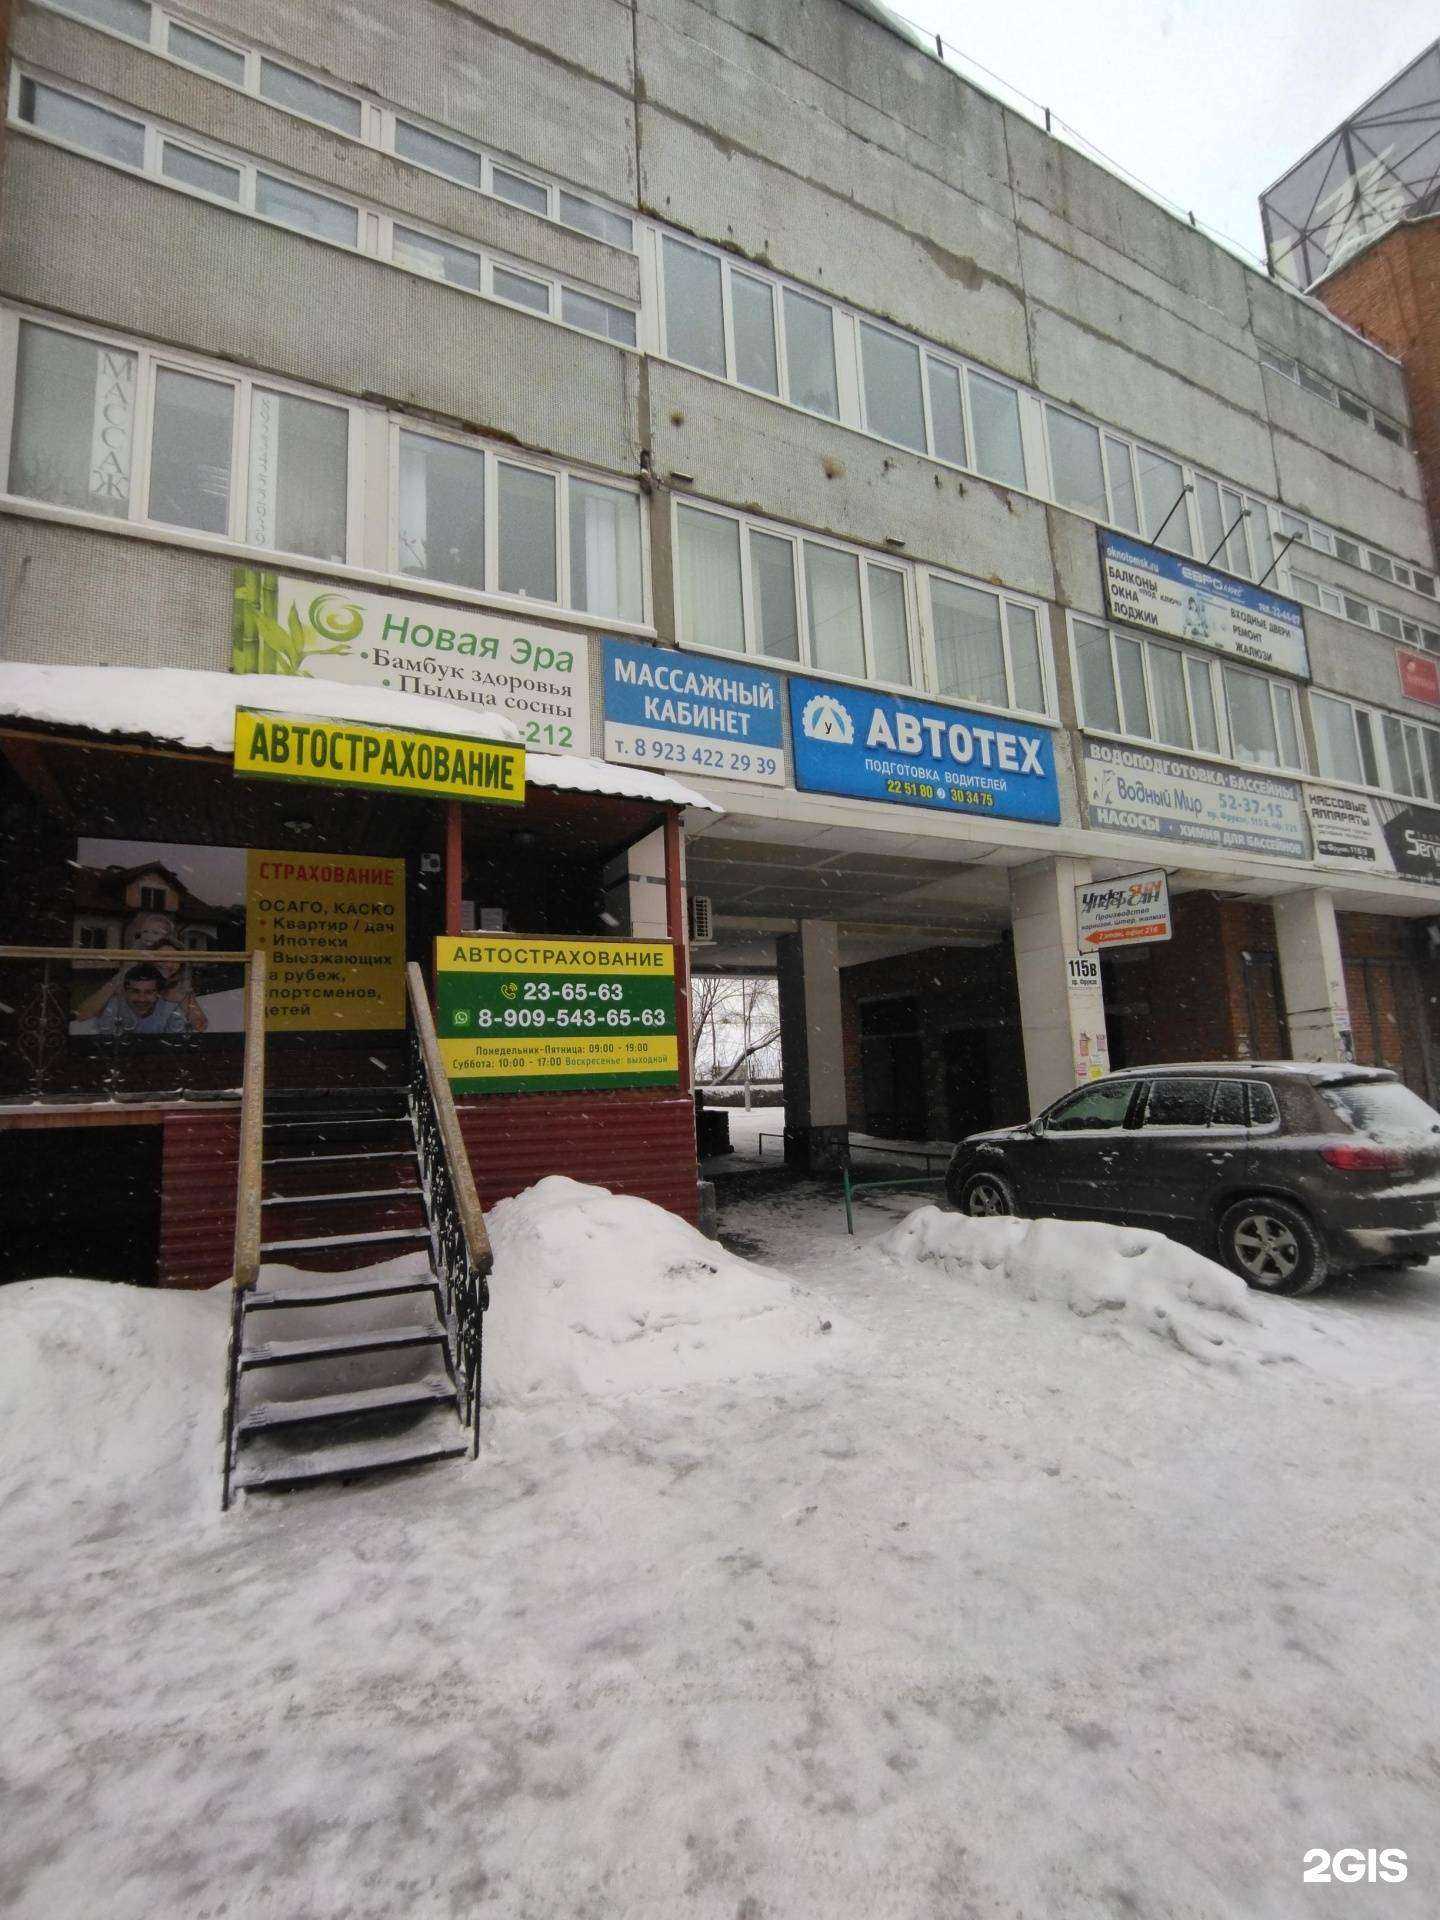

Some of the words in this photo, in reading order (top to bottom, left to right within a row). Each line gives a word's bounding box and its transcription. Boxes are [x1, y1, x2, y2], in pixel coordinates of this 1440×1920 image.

[92, 352, 136, 500] МАССАЖ
[1108, 567, 1158, 592] БАЛКОНЫ
[1111, 584, 1139, 602] ОКНА
[1114, 602, 1158, 625] ЛОДЖИИ
[1230, 608, 1268, 630] ВХОДНЫЕ
[1269, 623, 1292, 638] ДВЕРИ
[381, 613, 499, 659] Новая
[510, 638, 574, 673] Эра
[1232, 625, 1263, 643] РЕМОНТ
[1235, 642, 1273, 661] ЖАЛЮЗИ
[372, 647, 464, 680] Бамбук
[471, 670, 572, 697] здоровья
[614, 658, 774, 710] МАССАЖНЫЙ
[399, 674, 497, 707] Пыльца
[504, 695, 573, 718] сосны
[644, 696, 750, 736] КАБИНЕТ
[866, 708, 1045, 777] АВТОТЕХ
[250, 722, 514, 791] АВТОСТРАХОВАНИЕ
[615, 740, 628, 754] т.
[634, 738, 647, 757] 8
[652, 741, 686, 762] 923
[692, 747, 724, 768] 422
[730, 753, 750, 771] 29
[756, 757, 777, 775] 39
[865, 758, 940, 782] ПОДГОТОВКА
[944, 771, 1007, 791] ВОДИТЕЛЕЙ
[1117, 776, 1172, 808] Водный
[1173, 788, 1202, 818] Мир
[1309, 794, 1368, 813] КАССОВЫЕ
[1097, 807, 1160, 832] НАСОСЫ
[1311, 808, 1370, 826] АППАРАТЫ
[260, 863, 395, 886] СТРАХОВАНИЕ
[259, 899, 328, 915] ОСАГО,
[334, 902, 395, 916] КАСКО
[273, 918, 348, 933] Квартир
[365, 922, 394, 934] дач
[273, 935, 348, 949] Ипотеки
[273, 952, 392, 966] Выезжающих
[453, 946, 664, 967] АВТОСТРАХОВАНИЕ
[285, 969, 346, 982] рубеж,
[523, 982, 623, 1001] 23-65-63
[478, 1009, 666, 1027] 8-909-543-65-63
[588, 1044, 614, 1053] 09:00
[625, 1042, 648, 1052] 19:00
[453, 1060, 494, 1071] Суббота:
[499, 1058, 525, 1068] 10:00
[538, 1057, 562, 1067] 17:00
[565, 1056, 622, 1067] Воскресенье:
[627, 1054, 668, 1064] выходной
